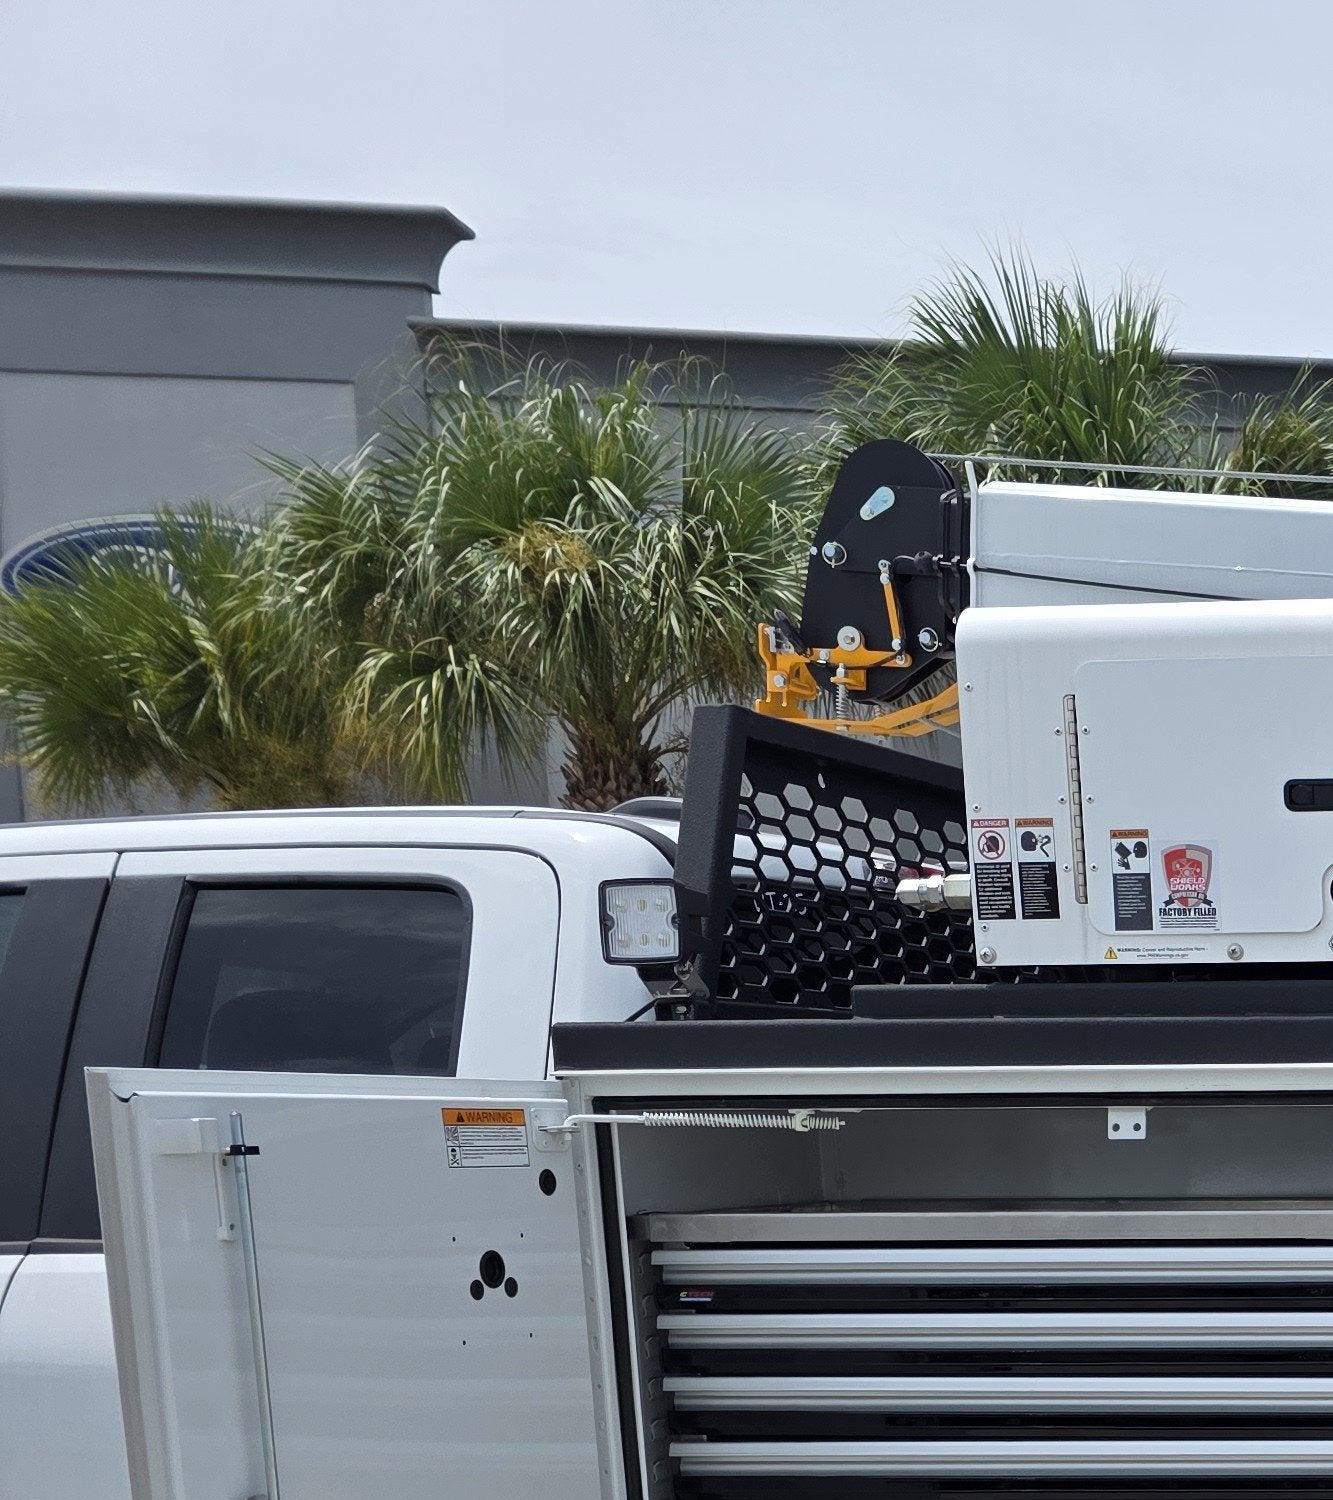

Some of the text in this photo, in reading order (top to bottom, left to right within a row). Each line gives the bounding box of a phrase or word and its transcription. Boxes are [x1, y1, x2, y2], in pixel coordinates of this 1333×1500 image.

[979, 819, 1007, 827] DANGER
[1022, 818, 1052, 826] WARNING
[1116, 829, 1148, 838] WARNING
[1158, 907, 1217, 917] FACTORY FILLED
[465, 1111, 513, 1123] WARNING
